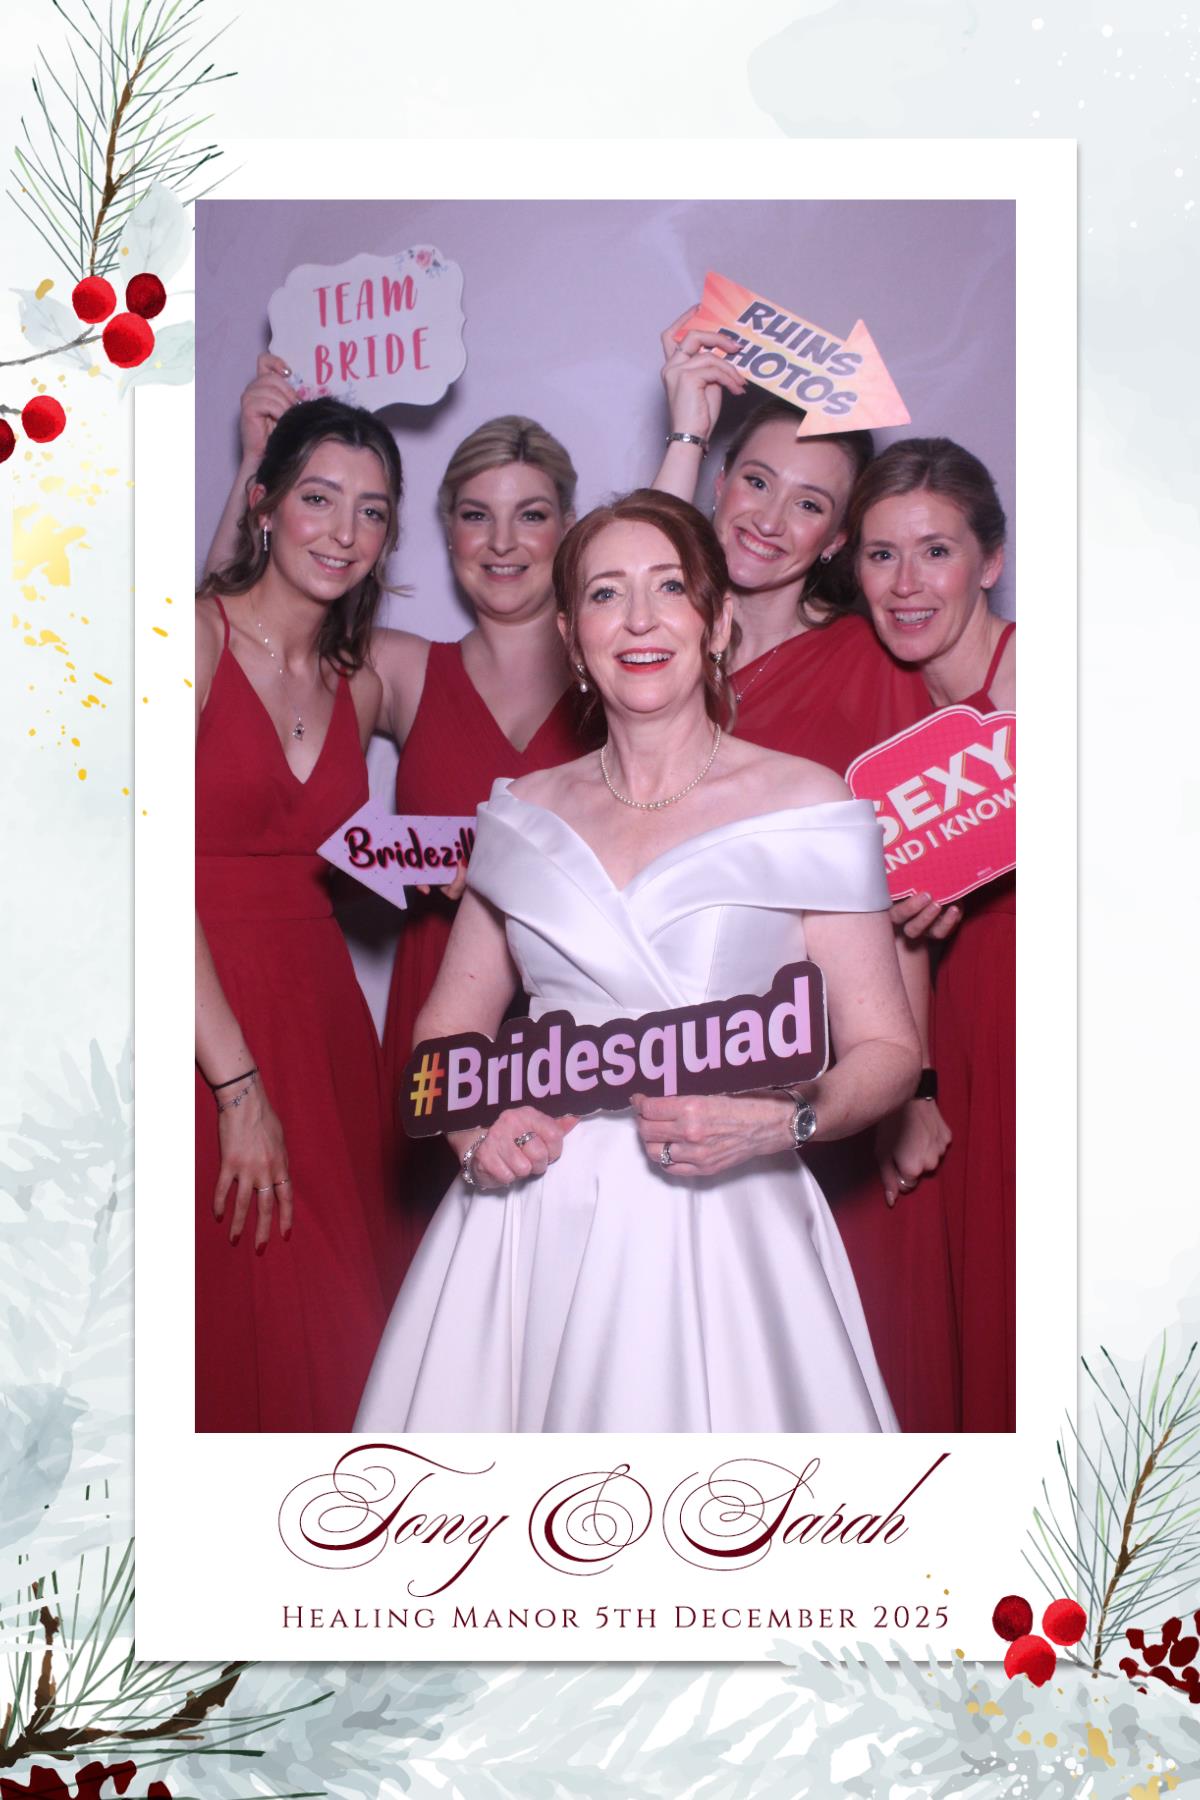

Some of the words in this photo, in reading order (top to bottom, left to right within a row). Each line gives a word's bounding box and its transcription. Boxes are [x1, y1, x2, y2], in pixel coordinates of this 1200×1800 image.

[313, 275, 418, 327] TEAM
[314, 326, 431, 386] BRIDE
[737, 301, 863, 377] RUINS
[344, 826, 476, 869] Bridezill
[885, 839, 924, 874] ND
[925, 830, 939, 848] I
[410, 975, 812, 1117] #Bridesquad
